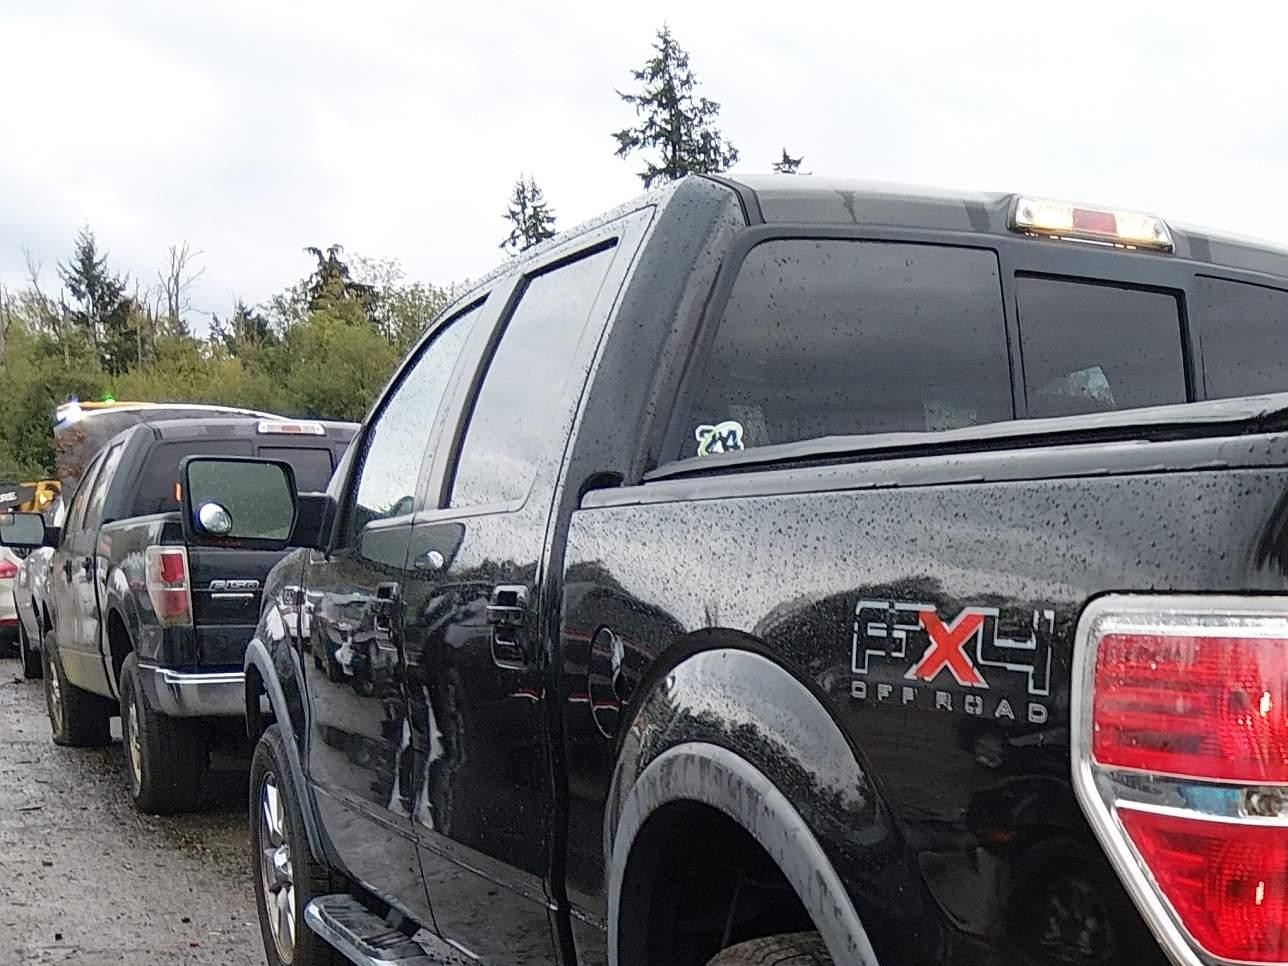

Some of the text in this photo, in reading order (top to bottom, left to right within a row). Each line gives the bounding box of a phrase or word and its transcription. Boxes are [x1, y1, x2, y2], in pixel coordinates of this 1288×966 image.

[852, 600, 1055, 696] FX4
[851, 680, 1049, 724] OFF ROAD
